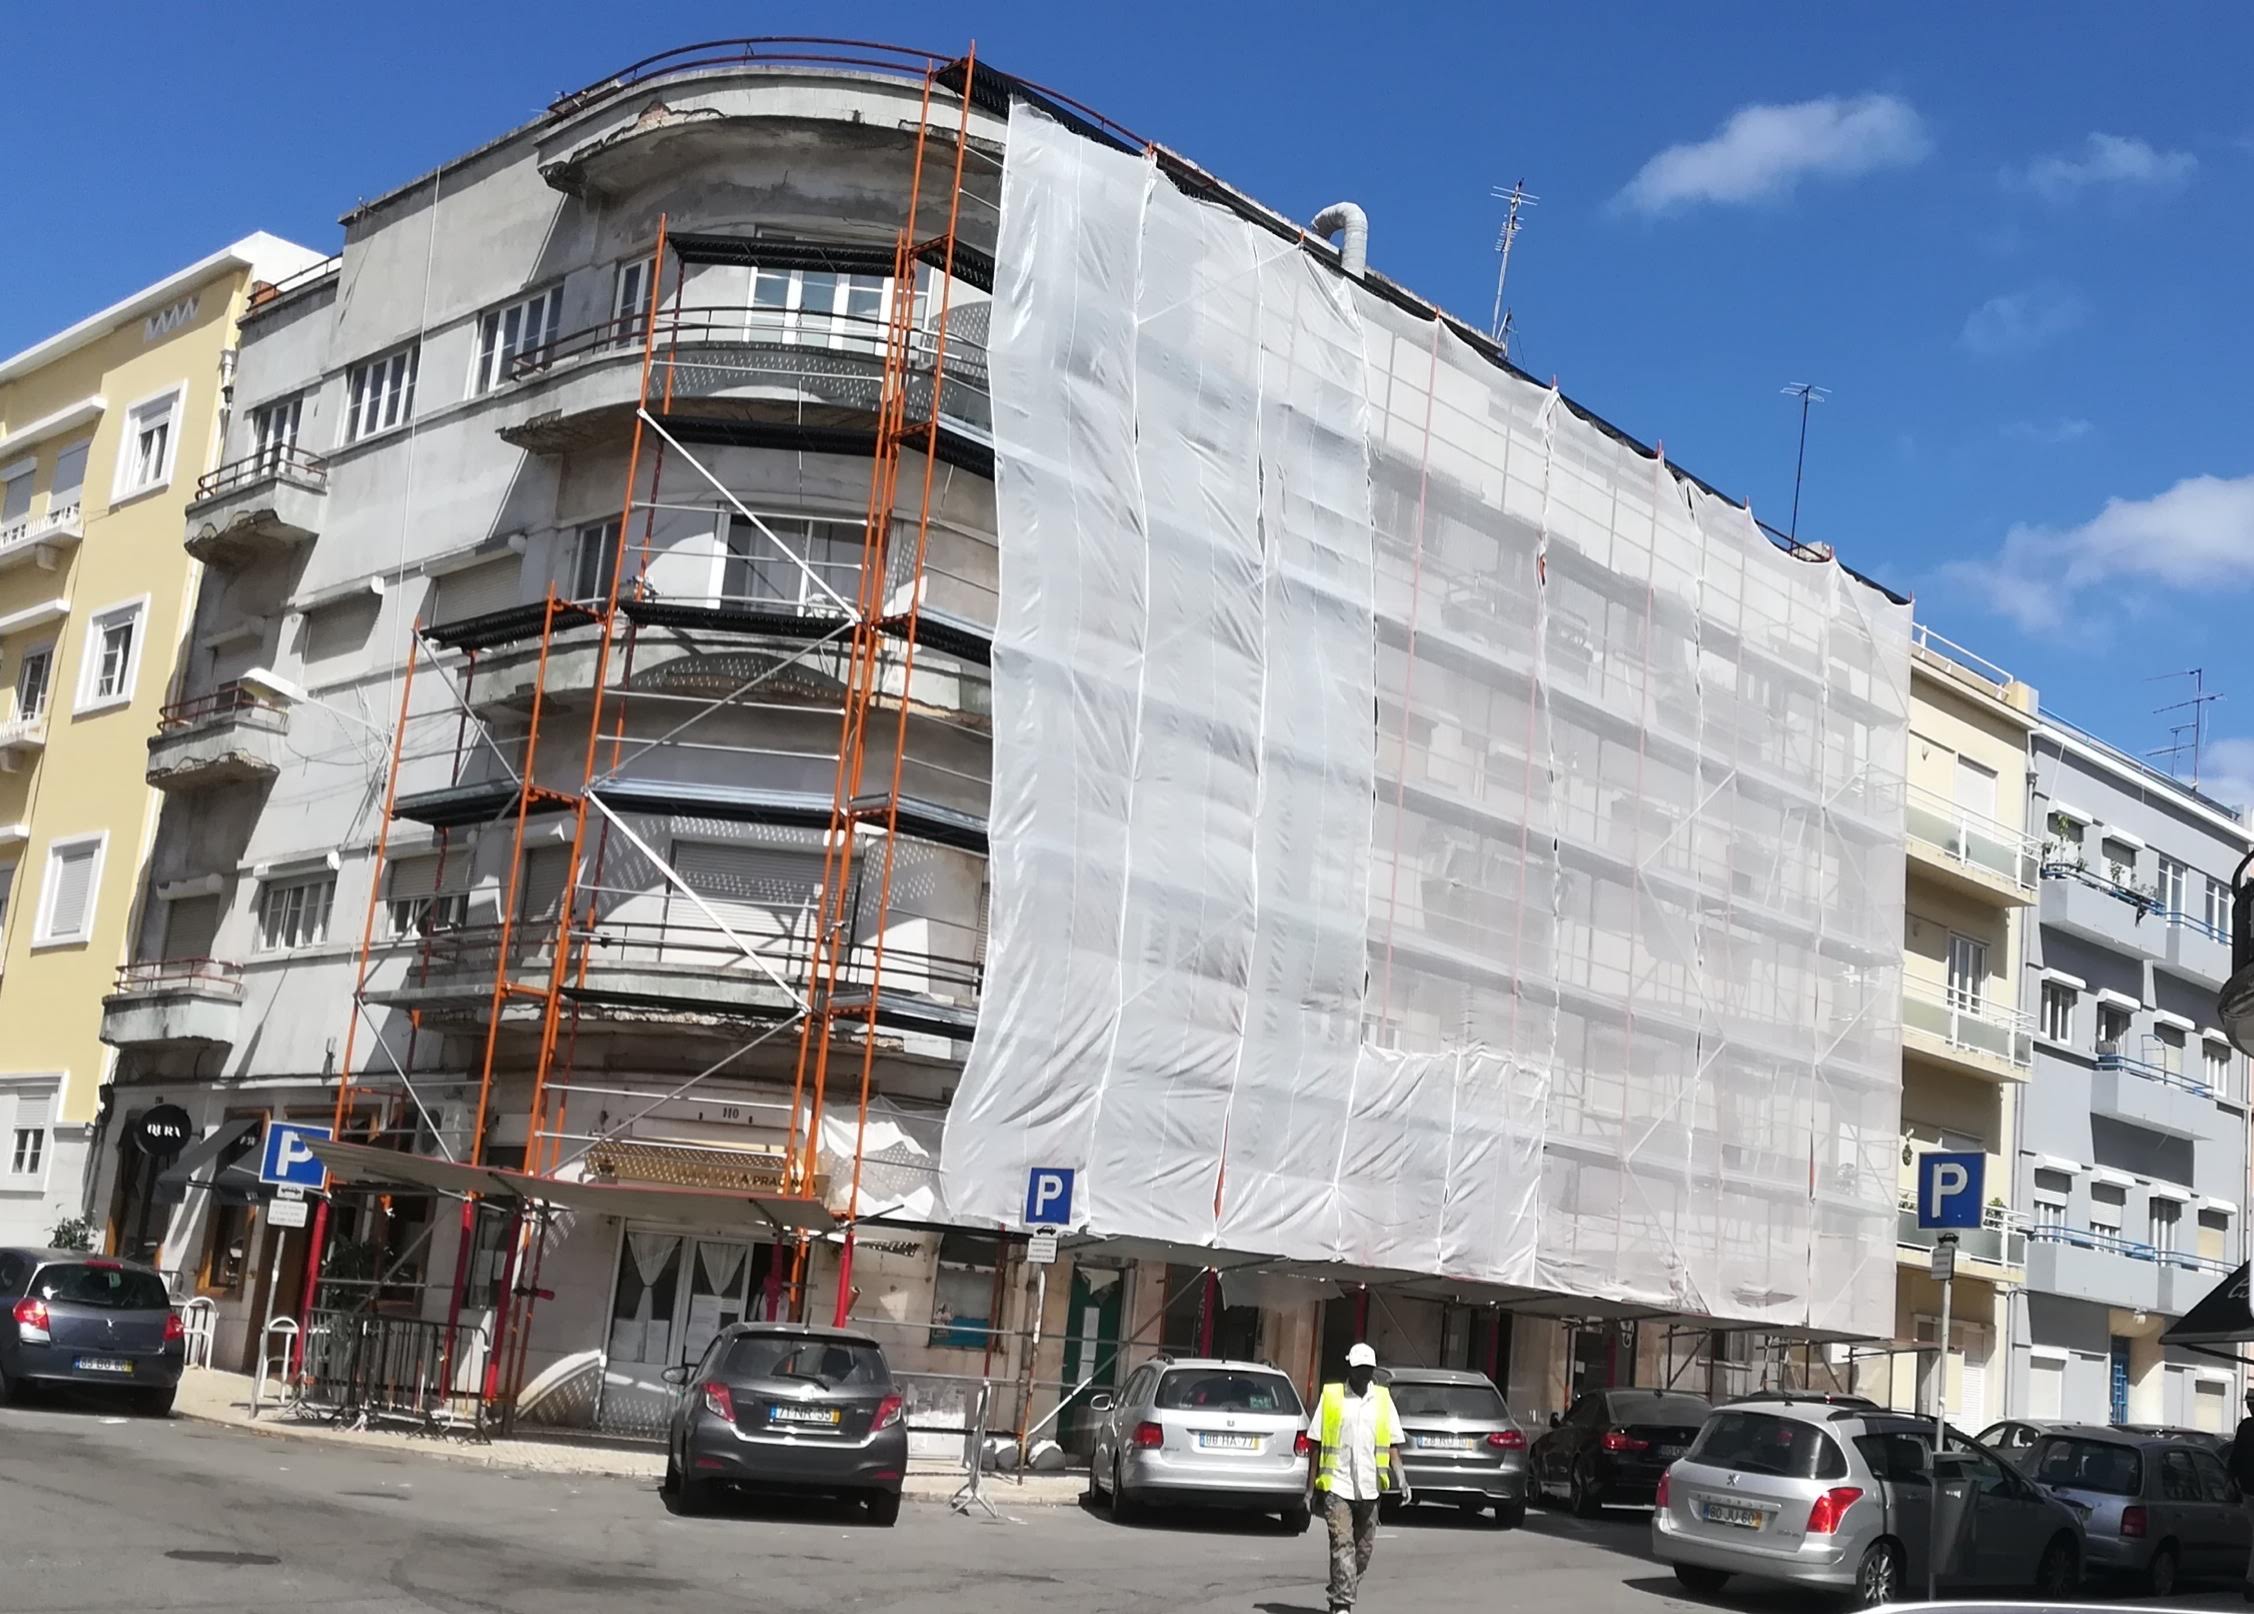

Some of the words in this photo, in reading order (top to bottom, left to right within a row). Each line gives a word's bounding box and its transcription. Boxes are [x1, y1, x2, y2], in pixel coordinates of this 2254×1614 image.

[276, 1131, 313, 1177] P
[1035, 1175, 1063, 1216] P
[1932, 1163, 1968, 1218] P
